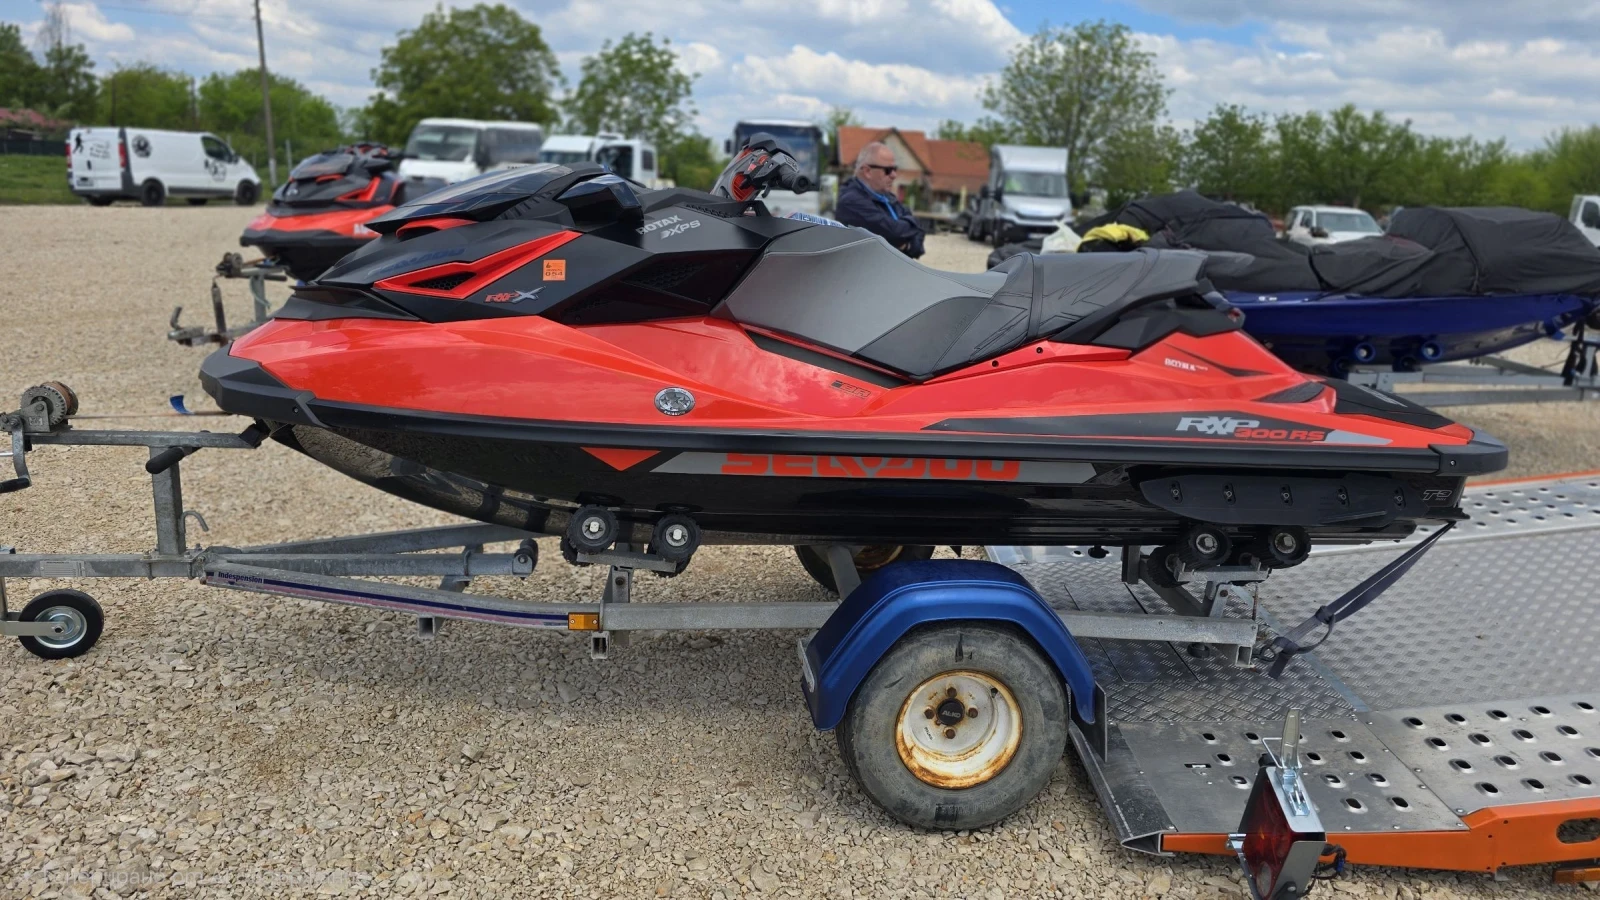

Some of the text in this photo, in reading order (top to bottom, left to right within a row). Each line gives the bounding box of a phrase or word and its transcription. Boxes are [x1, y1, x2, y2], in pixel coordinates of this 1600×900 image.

[635, 214, 684, 235] ROTAX
[668, 219, 701, 236] XPS
[1175, 416, 1326, 441] RXP 300 RS
[218, 571, 263, 583] Indespension
